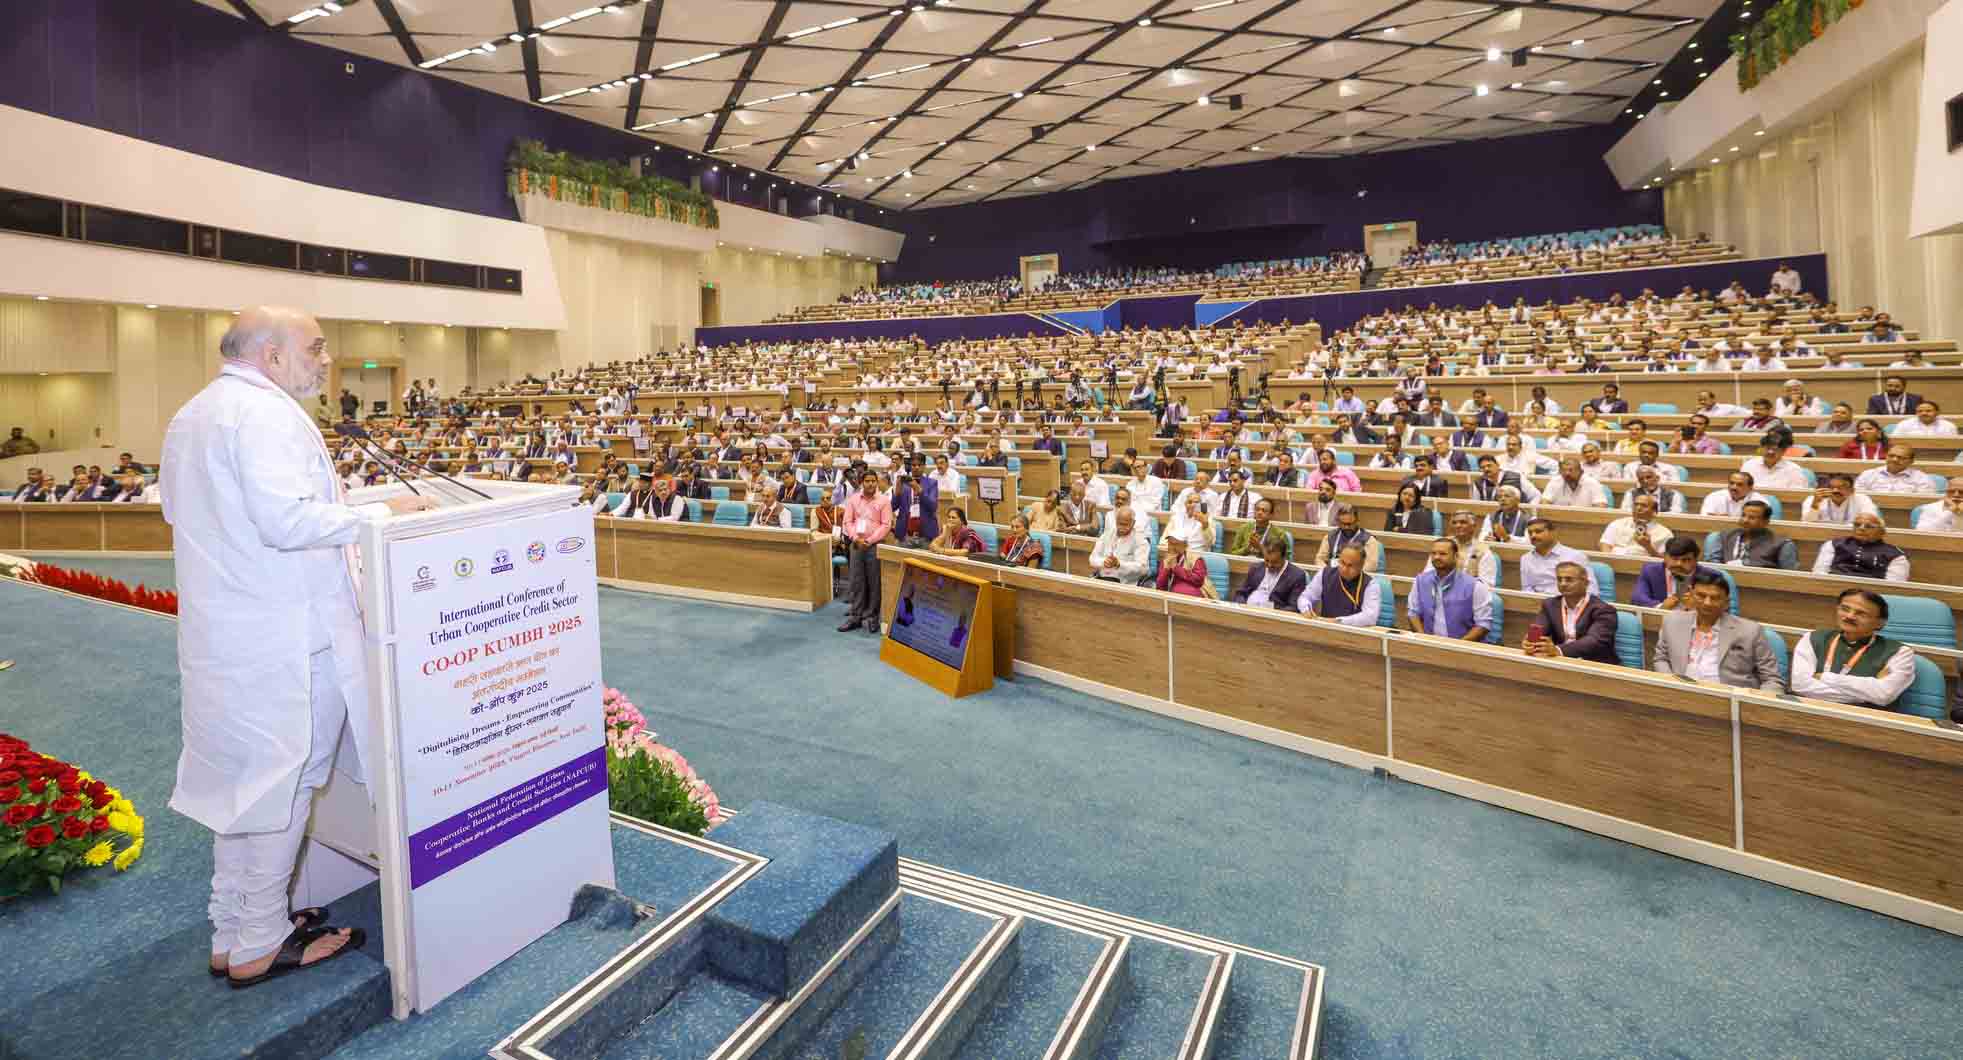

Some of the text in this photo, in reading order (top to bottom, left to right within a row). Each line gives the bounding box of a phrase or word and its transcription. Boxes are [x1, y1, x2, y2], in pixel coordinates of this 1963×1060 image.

[430, 595, 577, 645] Urban Cooperative Credit Sector
[440, 579, 565, 624] International Conference of
[423, 616, 581, 675] CO-OP KUMBH 2025
[526, 680, 548, 695] 2025
[472, 720, 500, 735] Dreams
[506, 701, 548, 721] Empowering
[425, 825, 470, 850] Cooperative
[473, 813, 494, 827] Banks
[496, 803, 510, 815] and
[511, 793, 532, 807] Credit
[534, 781, 561, 797] Societies
[467, 770, 564, 820] National Federation of Urban
